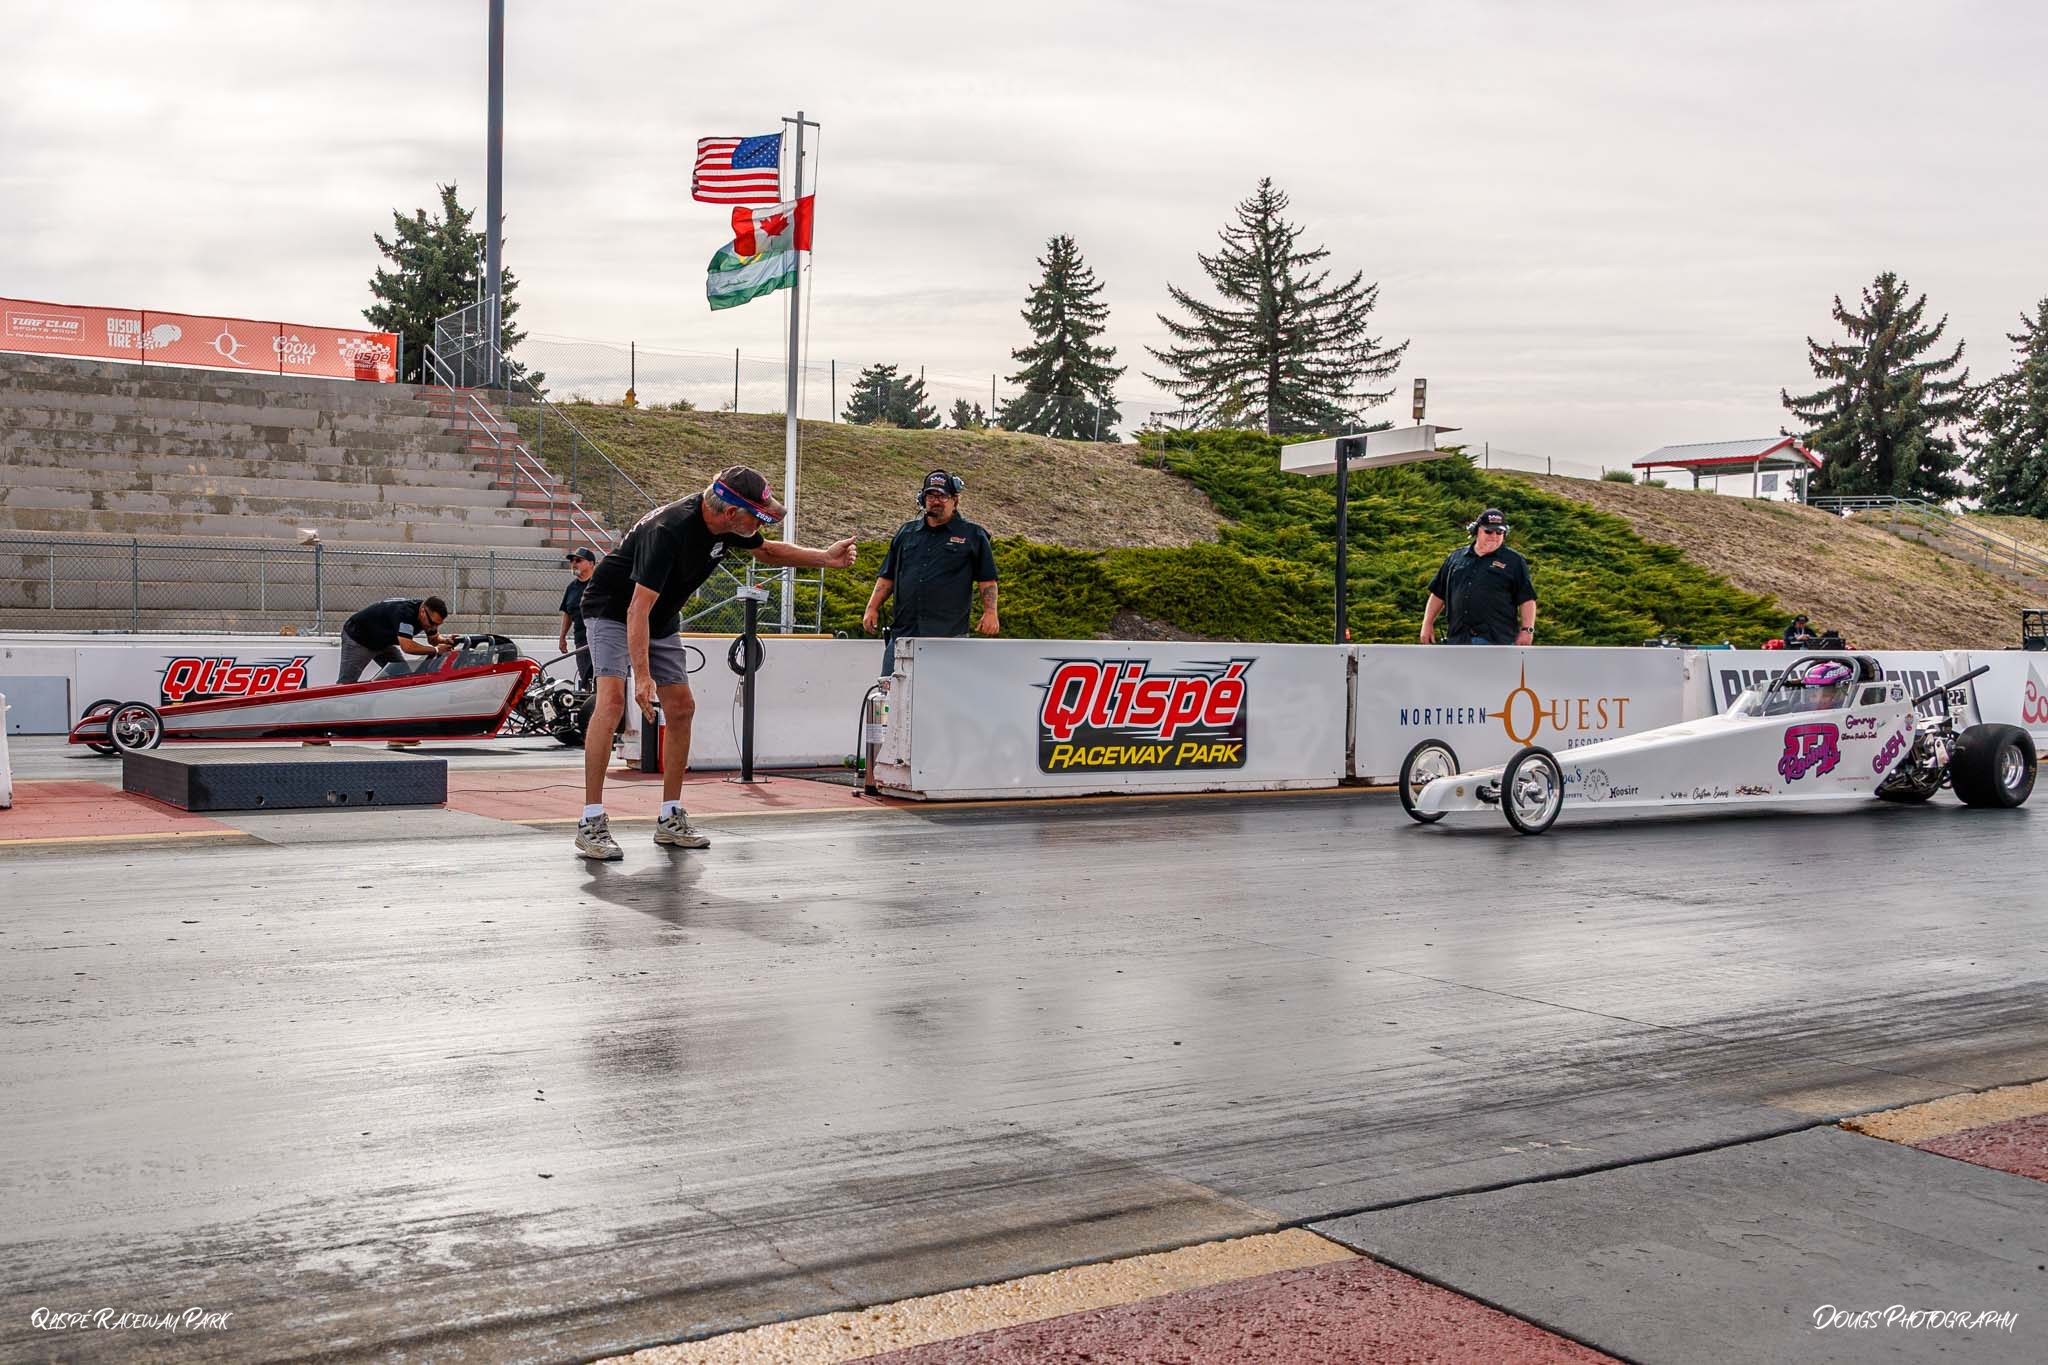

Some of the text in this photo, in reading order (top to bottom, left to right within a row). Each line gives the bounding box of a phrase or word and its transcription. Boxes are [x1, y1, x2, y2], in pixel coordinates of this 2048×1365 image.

[107, 318, 142, 334] BISON
[107, 333, 131, 348] TIRE
[272, 335, 317, 356] Coors
[277, 353, 313, 365] LIGHT
[162, 657, 306, 700] Qlispé
[1041, 660, 1248, 742] Qlispé
[1400, 684, 1630, 748] NORTHERN QUEST
[1048, 742, 1243, 769] RACEWAY PARK
